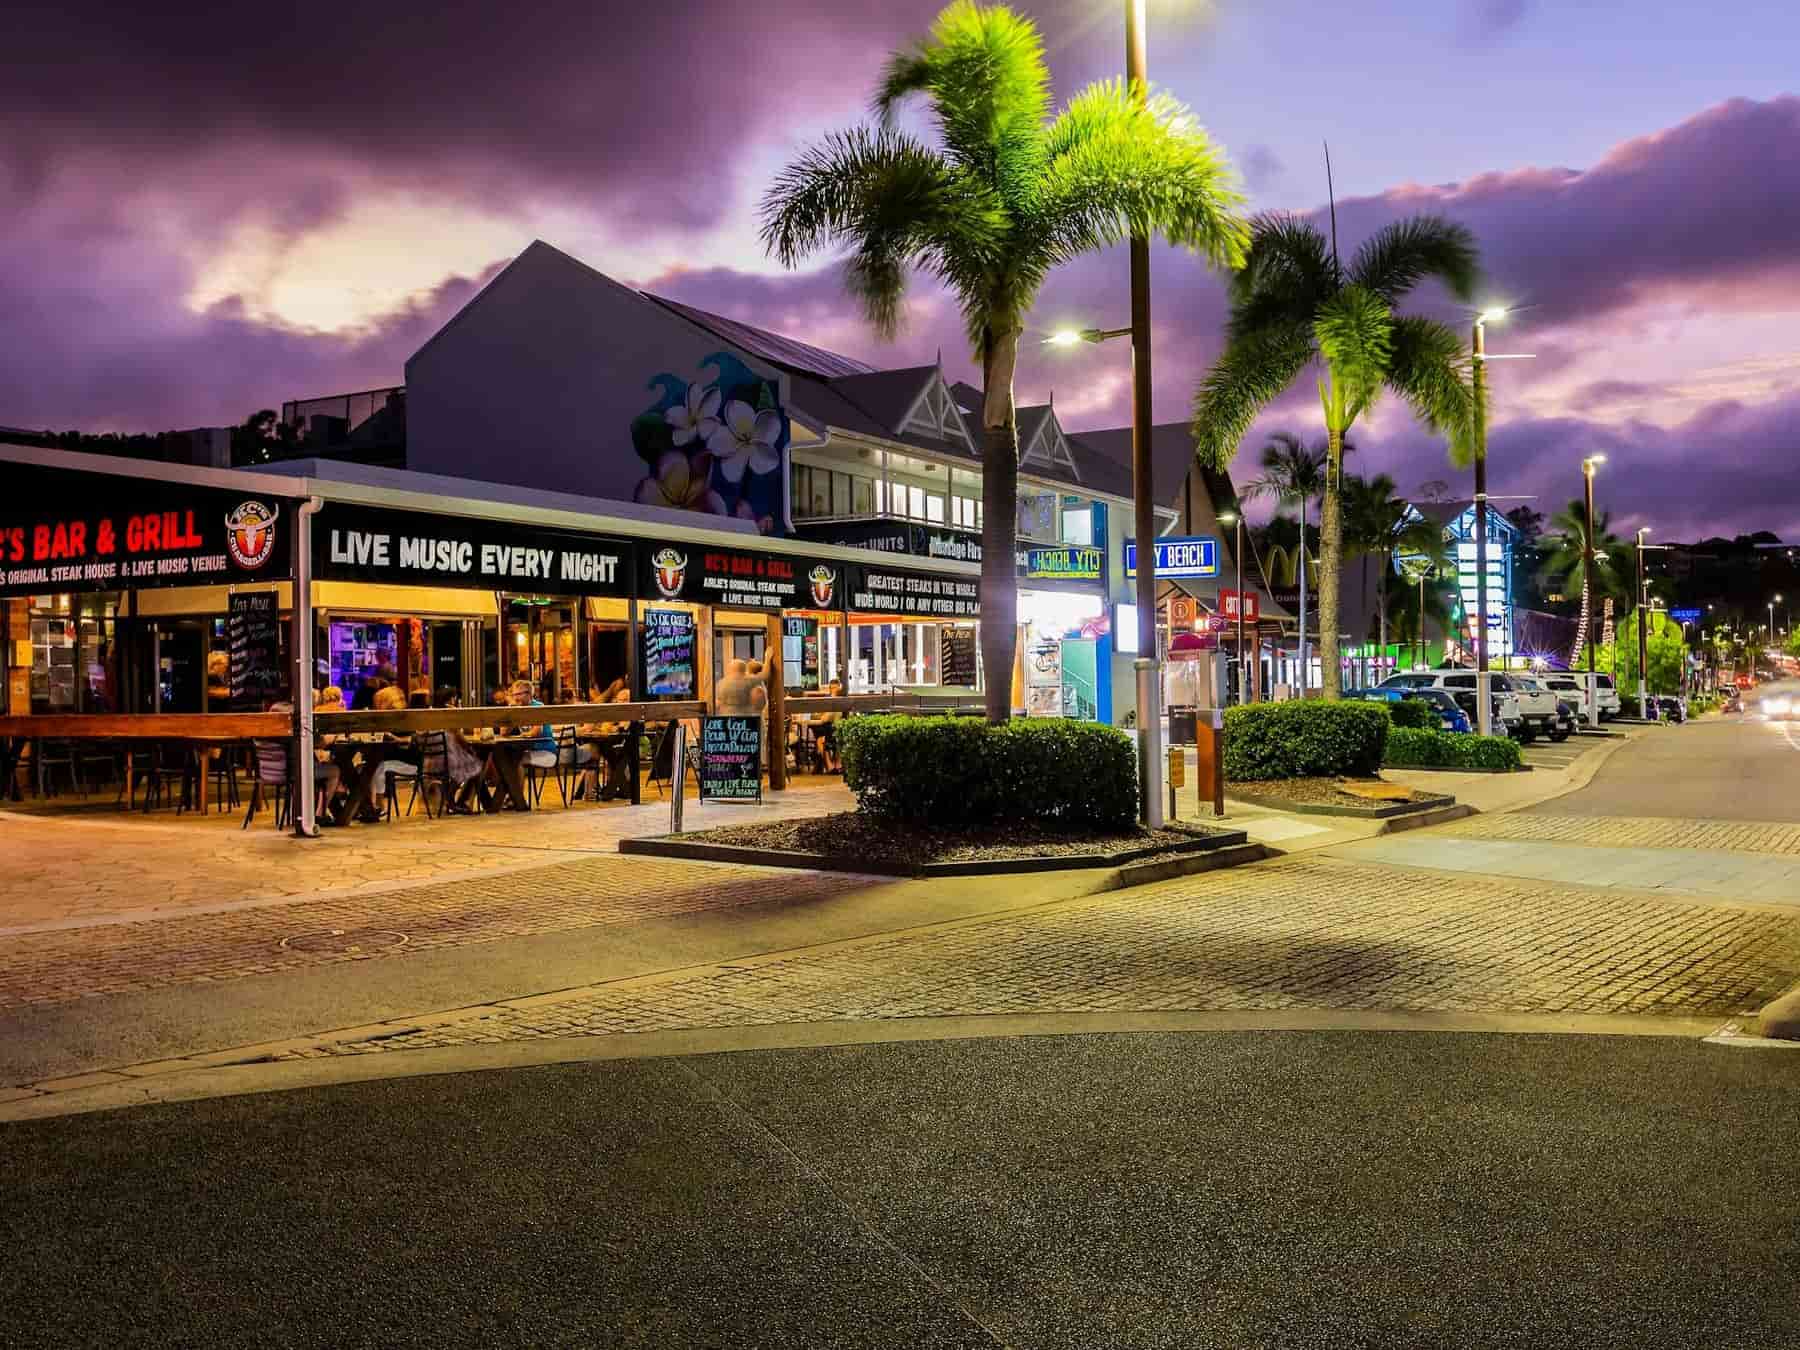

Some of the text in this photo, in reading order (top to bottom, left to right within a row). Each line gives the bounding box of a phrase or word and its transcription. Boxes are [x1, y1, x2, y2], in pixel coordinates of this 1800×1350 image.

[33, 520, 87, 560] BAR
[95, 518, 116, 554] &
[127, 510, 203, 554] GRILL
[331, 528, 390, 565] LIVE
[399, 537, 473, 573] MUSIC
[481, 544, 554, 579] EVERY
[561, 551, 619, 584] NIGHT
[1168, 544, 1204, 566] BEACH
[8, 569, 49, 585] ORIGINAL
[51, 565, 82, 582] STEAK
[84, 562, 117, 580] HOUSE
[132, 558, 154, 576] LIVE
[157, 557, 189, 574] MUSIC
[192, 554, 227, 571] VENUE
[732, 557, 753, 575] BAR
[757, 560, 764, 575] &
[768, 561, 793, 578] GRILL
[729, 579, 755, 592] ORIGINAL
[757, 582, 777, 593] STEAK
[777, 584, 796, 594] HOUSE
[868, 574, 977, 596] GREATEST STEAKS IN THE WHOLE
[729, 595, 742, 605] LIVE
[743, 596, 761, 605] MUSIC
[763, 596, 782, 606] VENUE
[855, 592, 873, 608] WIDE
[875, 594, 899, 610] WORLD
[906, 597, 915, 610] OR
[917, 598, 931, 612] ANY
[933, 598, 954, 613] OTHER
